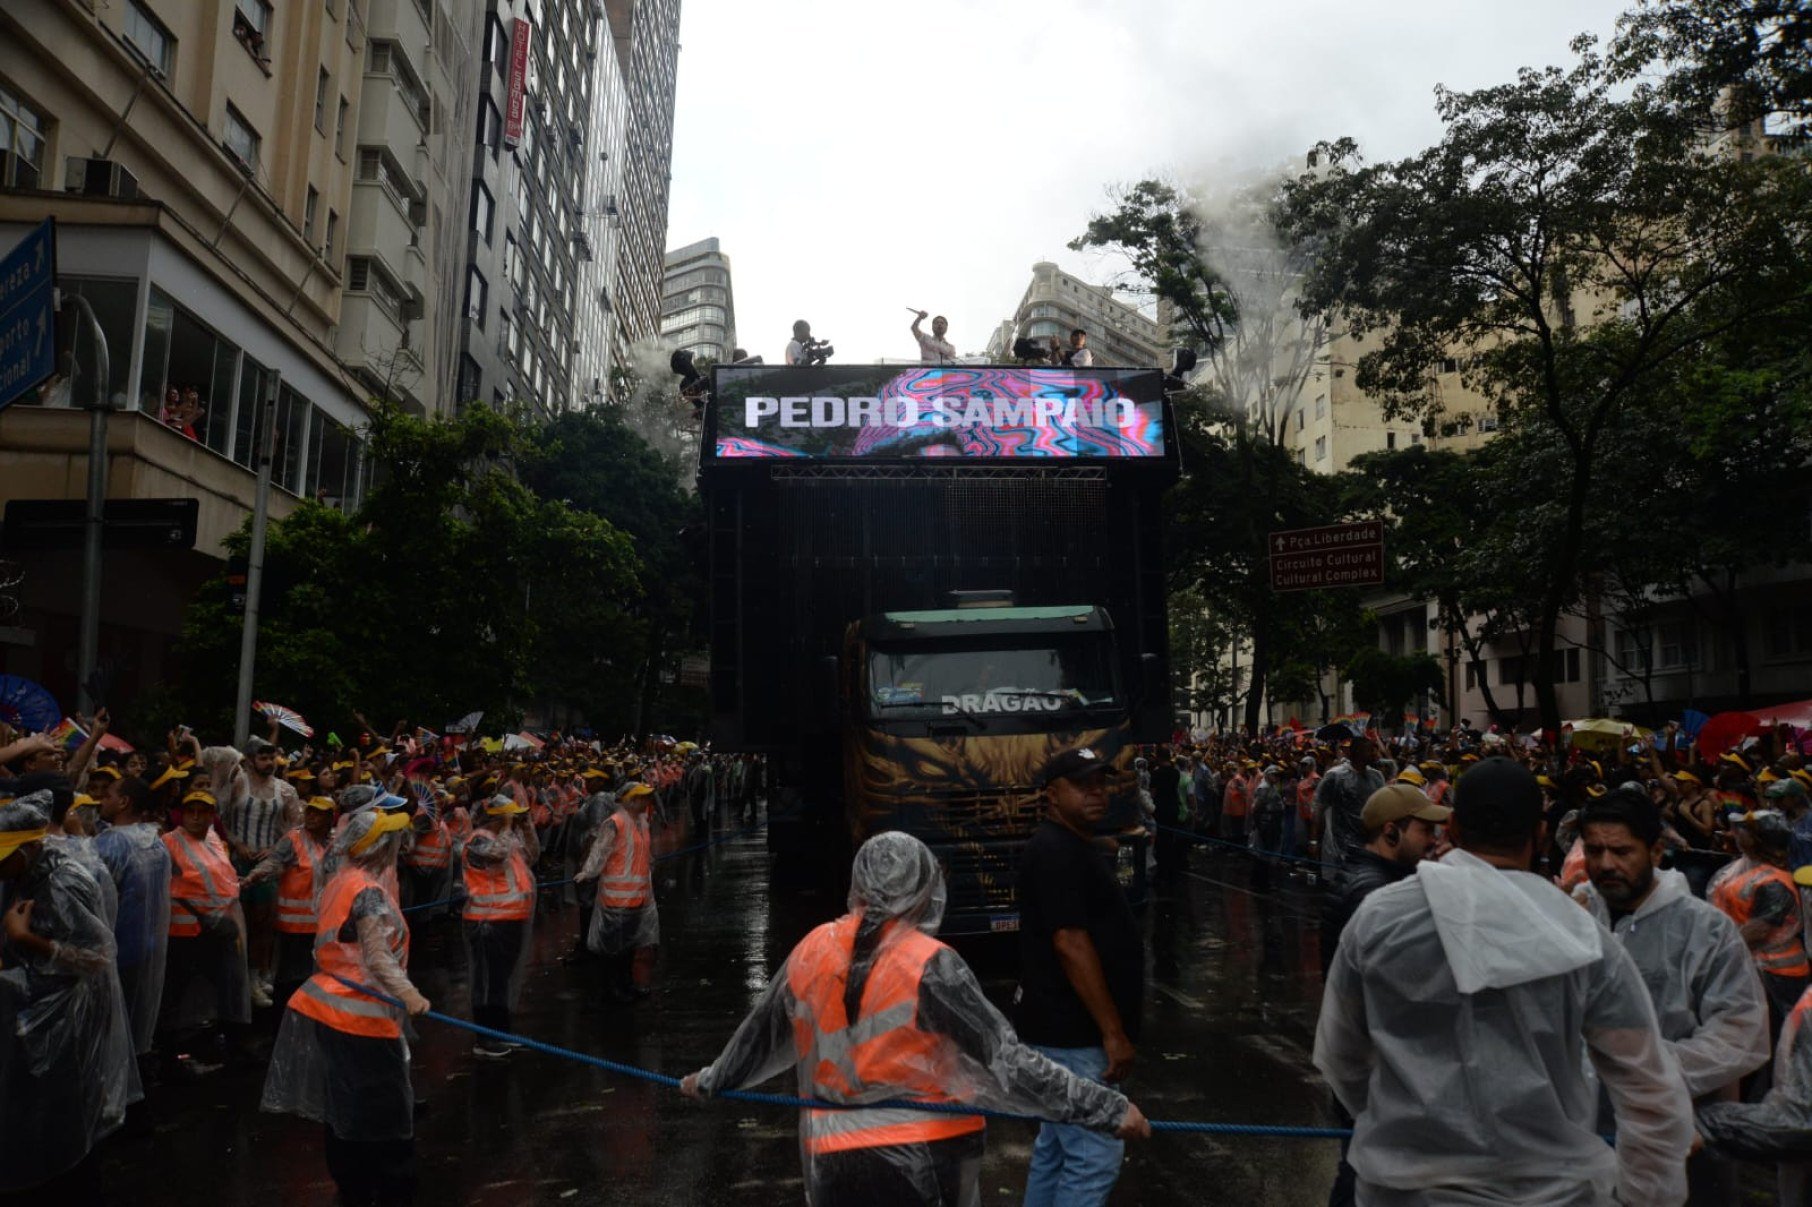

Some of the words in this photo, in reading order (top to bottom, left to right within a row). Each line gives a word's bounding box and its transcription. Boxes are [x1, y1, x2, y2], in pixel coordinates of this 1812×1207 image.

[744, 396, 919, 428] PEDRO
[931, 396, 1136, 428] SAMPAIO
[1289, 536, 1311, 549] Pça
[1314, 527, 1376, 544] Liberdade
[1276, 557, 1322, 571] Circuito
[1326, 550, 1376, 566] Cultural
[1276, 571, 1321, 586] Cultural
[1325, 567, 1378, 581] Complex
